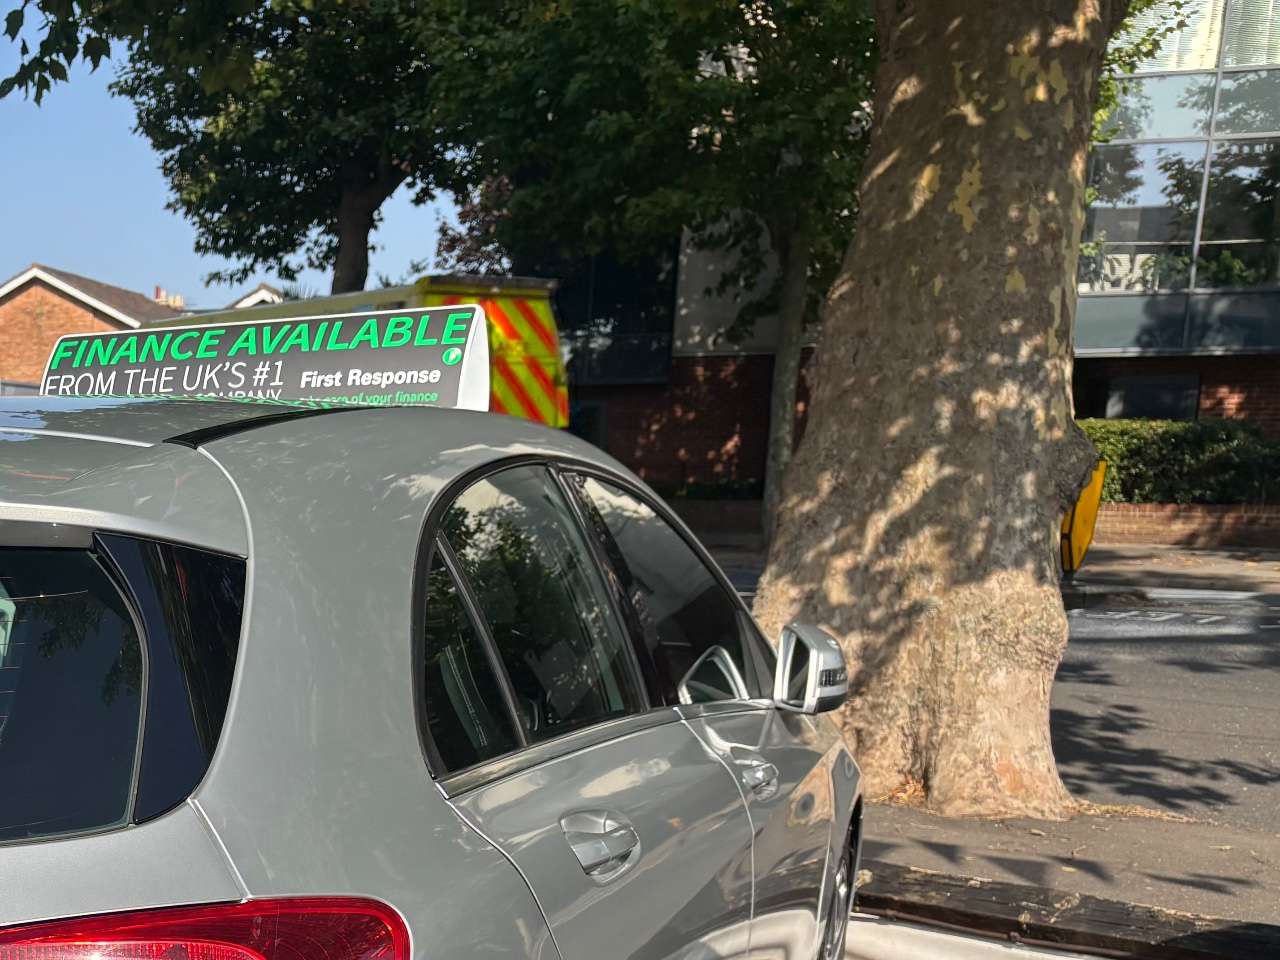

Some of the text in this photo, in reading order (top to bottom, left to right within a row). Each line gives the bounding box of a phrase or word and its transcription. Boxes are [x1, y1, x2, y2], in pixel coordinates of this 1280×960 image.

[50, 312, 473, 370] FINANCE AVAILABLE
[45, 360, 284, 396] FROM THE UK'S #1
[300, 368, 441, 389] First Response
[395, 391, 439, 404] finance
